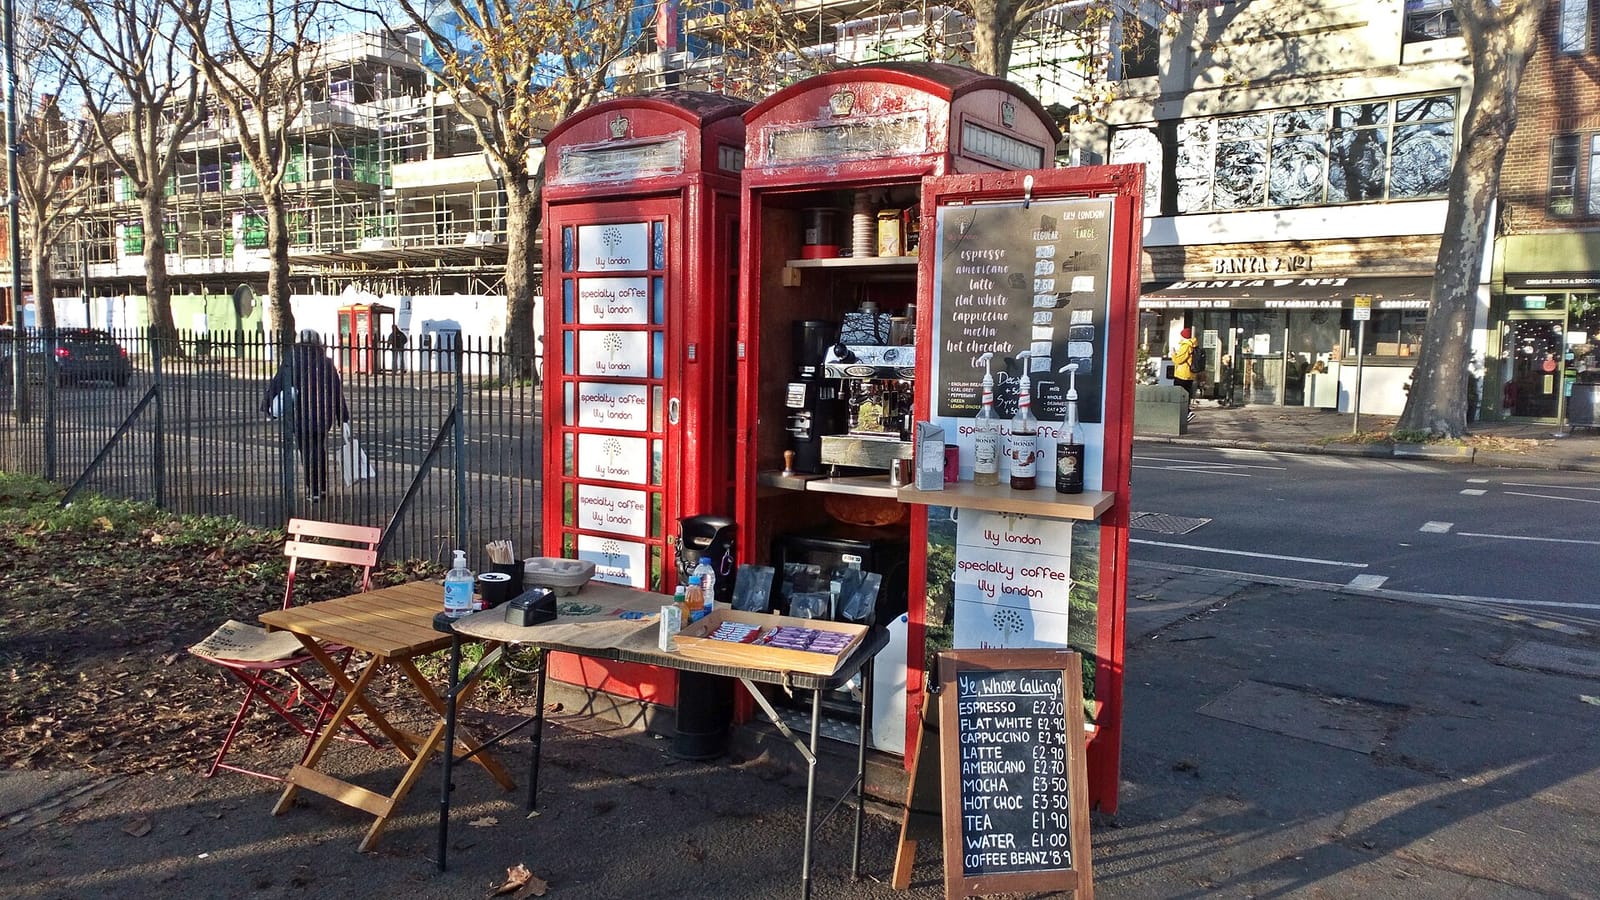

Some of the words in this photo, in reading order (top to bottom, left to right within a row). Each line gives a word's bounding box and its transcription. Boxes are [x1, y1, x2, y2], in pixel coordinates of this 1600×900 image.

[1078, 209, 1104, 220] LONDON
[596, 256, 606, 269] lily
[608, 256, 630, 265] london
[960, 250, 1005, 262] espresso
[956, 264, 1008, 275] americano
[1213, 256, 1268, 274] BANYA
[970, 278, 994, 290] latte
[1166, 280, 1266, 290] BANYA
[581, 288, 616, 302] specialty
[618, 287, 646, 298] coffee
[954, 293, 974, 307] flat
[978, 293, 1008, 307] white
[593, 304, 604, 318] lily
[608, 304, 634, 314] london
[952, 310, 1009, 326] cappuccino
[964, 324, 997, 337] mocha
[946, 340, 963, 353] hot
[966, 340, 1014, 353] chocolate
[596, 361, 606, 374] lily
[608, 361, 630, 370] london
[997, 371, 1020, 386] Deca
[581, 393, 616, 408] specialty
[618, 394, 646, 405] coffee
[997, 394, 1018, 408] Syru
[593, 408, 604, 422] lily
[608, 410, 632, 420] london
[596, 464, 606, 477] lily
[608, 466, 630, 476] london
[580, 496, 614, 512] specialty
[618, 500, 644, 512] coffee
[592, 512, 603, 525] lily
[606, 512, 632, 524] london
[984, 529, 1000, 546] lily
[1004, 531, 1042, 545] london
[606, 568, 628, 579] london
[958, 560, 1014, 580] specialty
[1020, 566, 1066, 582] coffee
[977, 579, 994, 598] lily
[1001, 582, 1044, 598] london
[982, 678, 1016, 694] Whose
[960, 702, 1016, 715] ESPRESSO
[960, 718, 992, 730] FLAT
[994, 717, 1032, 729] WHITE
[960, 732, 1030, 744] CAPPUCCINO
[963, 746, 1002, 759] LATTE
[962, 761, 1026, 774] AMERICANO
[963, 778, 1008, 792] MOCHA
[964, 796, 991, 810] HOT
[994, 796, 1024, 810] CHOC
[964, 814, 992, 831] TEA
[966, 833, 1016, 849] WATER
[965, 852, 1008, 868] COFFEE
[1010, 852, 1048, 865] BEANZ
